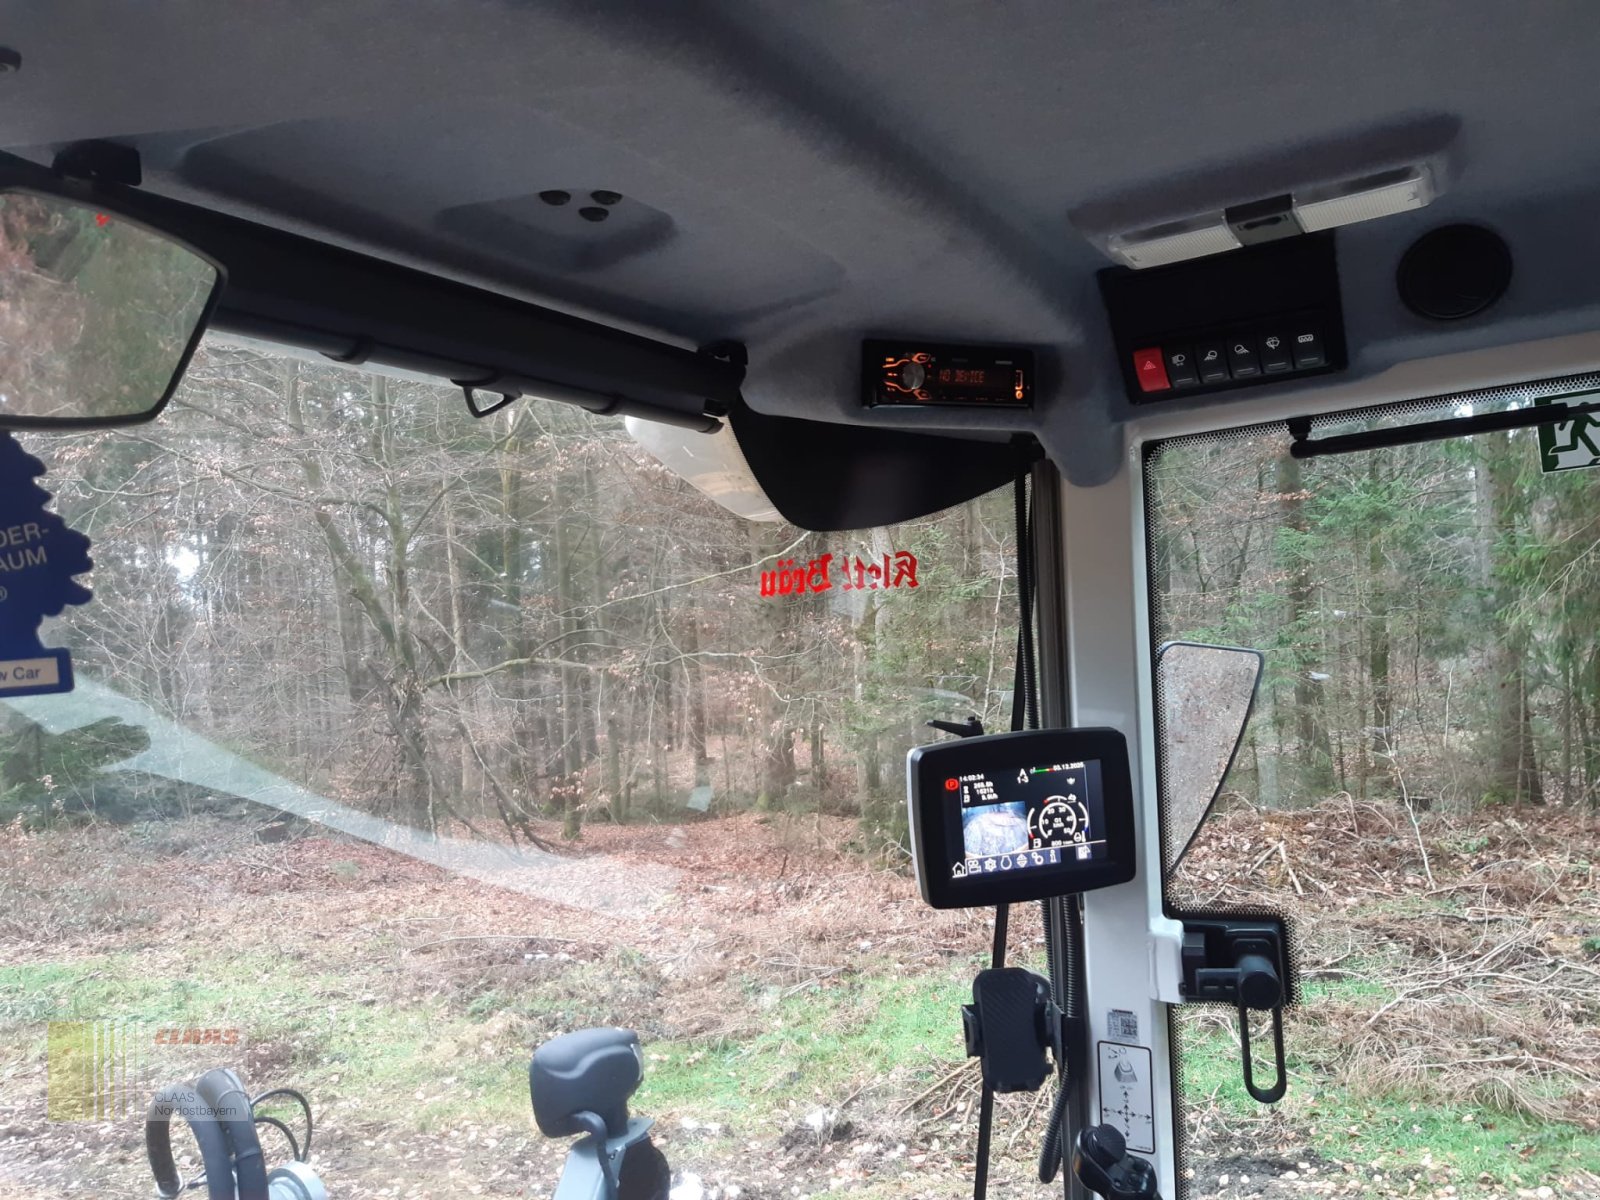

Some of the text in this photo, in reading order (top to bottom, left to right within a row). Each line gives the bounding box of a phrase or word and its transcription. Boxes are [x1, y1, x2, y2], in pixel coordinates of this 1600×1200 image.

[938, 369, 985, 384] NO DEVICE
[13, 665, 41, 681] Car
